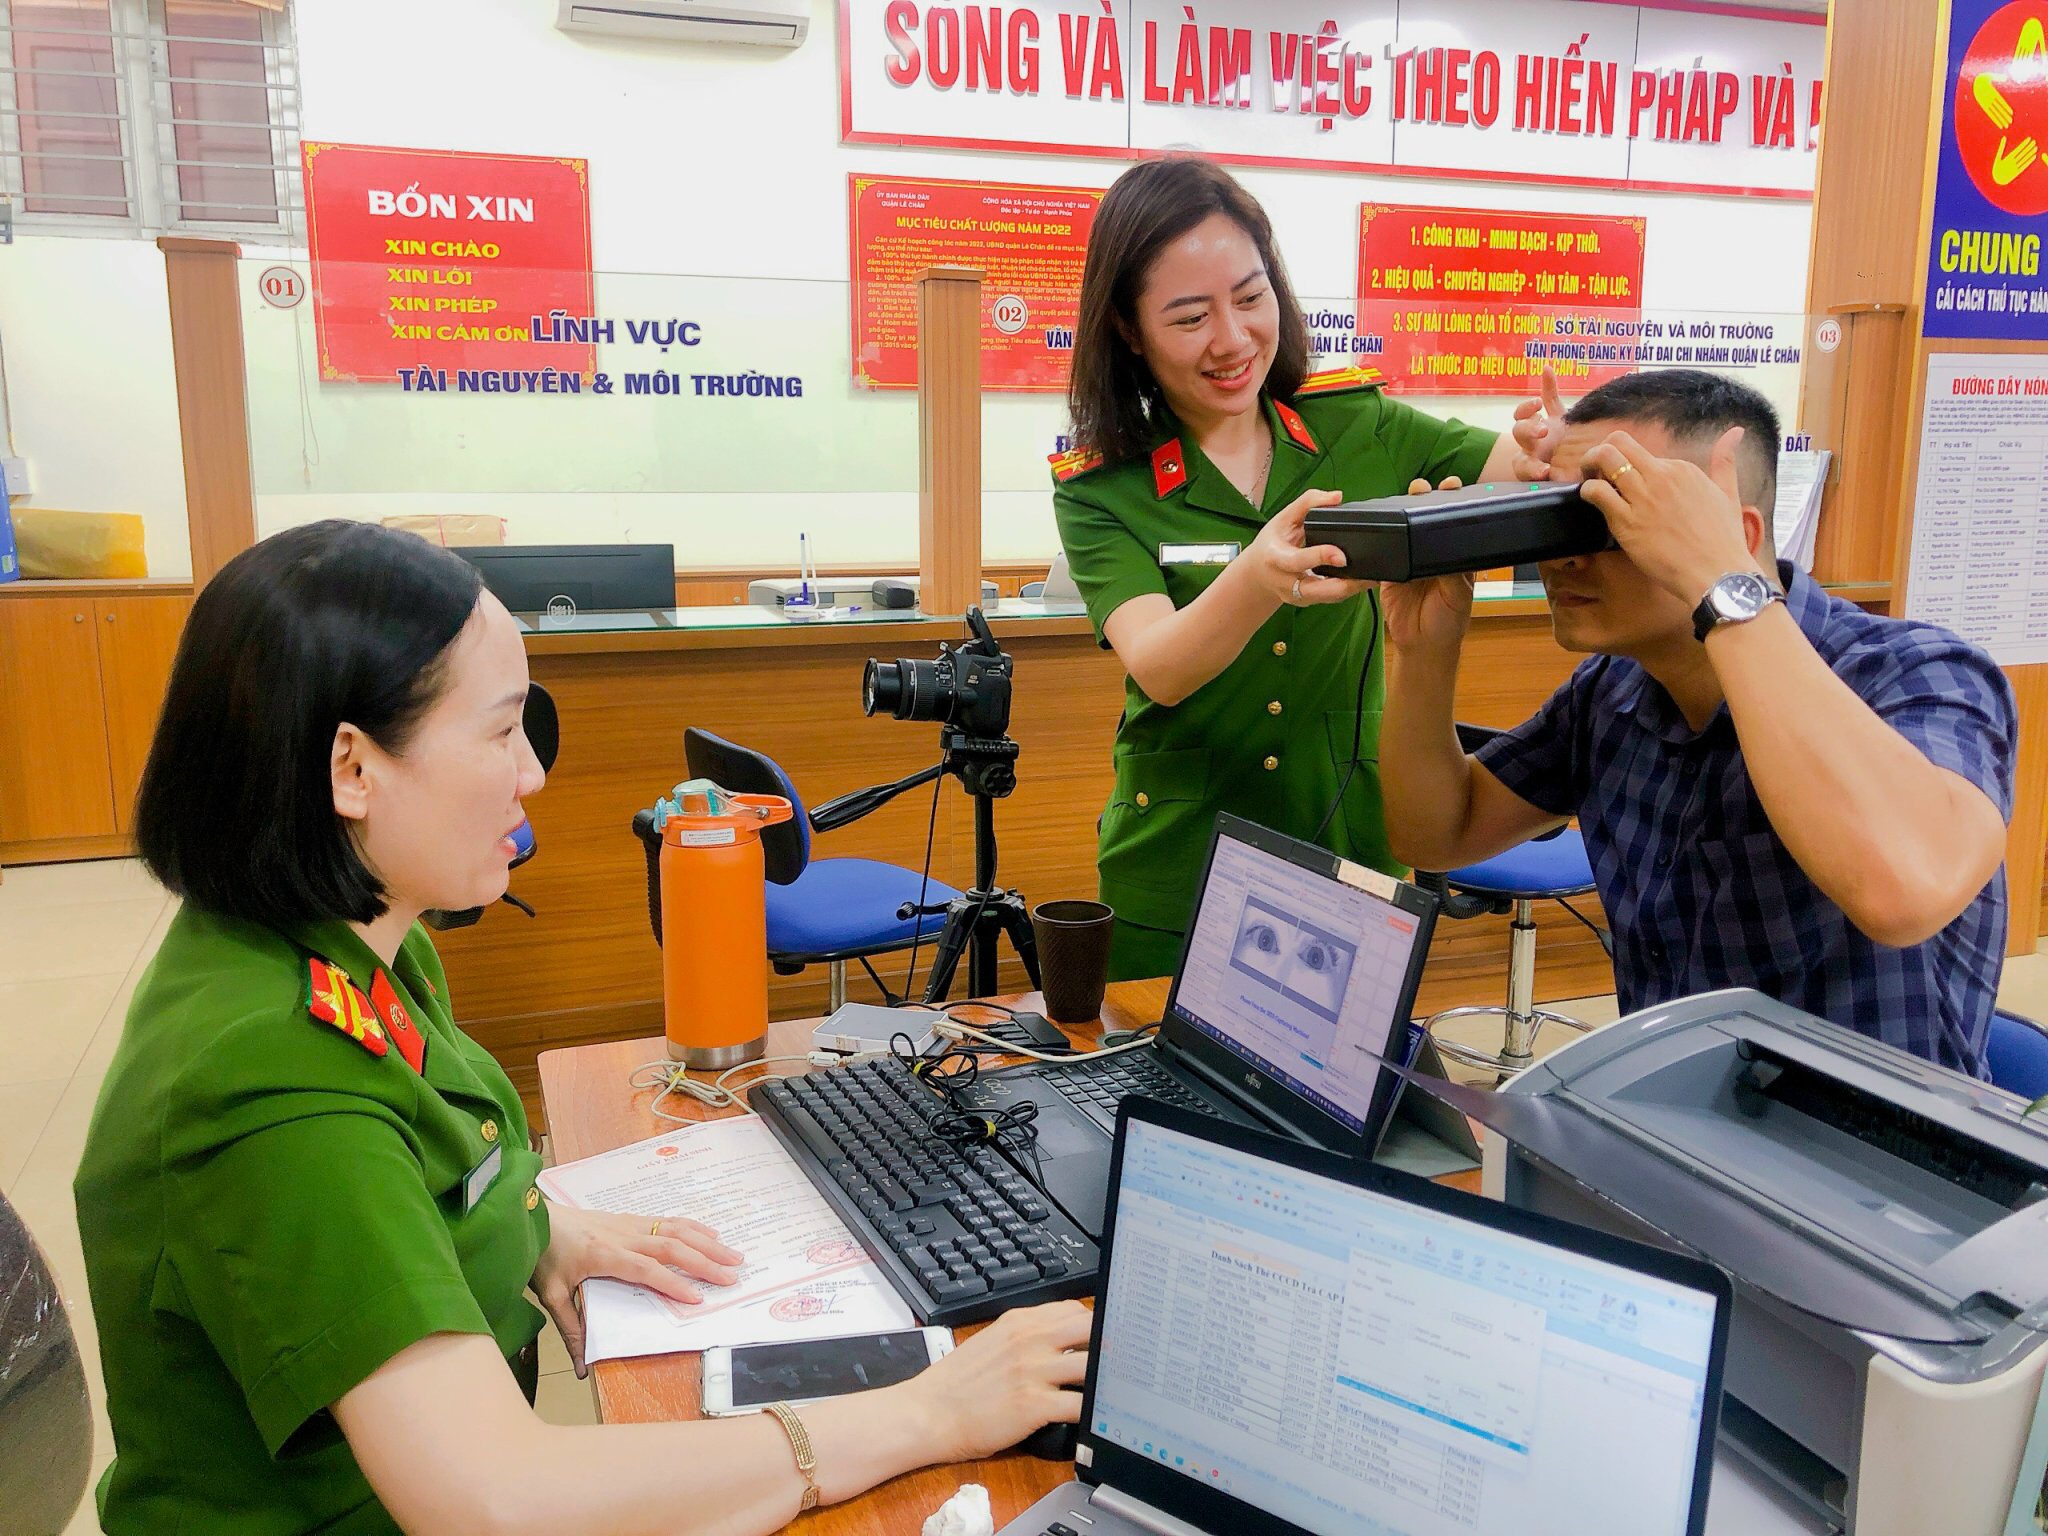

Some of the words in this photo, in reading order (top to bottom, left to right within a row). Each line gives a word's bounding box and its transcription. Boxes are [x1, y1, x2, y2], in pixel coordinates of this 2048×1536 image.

[1058, 0, 1125, 102] VÀ
[1143, 6, 1252, 108] LÀM
[1268, 19, 1373, 131] VIỆC
[1384, 45, 1500, 129] THEO
[1512, 33, 1617, 136] HIẾN
[1626, 56, 1738, 142] PHÁP
[1751, 62, 1795, 148] VÀ
[368, 181, 457, 219] BỐN
[466, 195, 535, 223] XIN
[896, 217, 920, 230] MỤC
[923, 216, 947, 229] TIÊU
[950, 217, 977, 231] CHẤT
[980, 221, 1015, 234] LƯỢNG
[1018, 222, 1041, 234] NĂM
[1043, 224, 1071, 235] 2022
[385, 239, 426, 255] XIN
[430, 239, 500, 258] CHÀO
[1411, 226, 1419, 245] 1.
[1423, 222, 1452, 247] CÔNG
[1455, 227, 1480, 248] KHAI
[1489, 229, 1517, 250] MINH
[1520, 231, 1547, 255] BẠCH
[1556, 233, 1573, 256] KỊP
[1576, 229, 1600, 253] THỜI.
[1940, 229, 2040, 276] CHUNG
[266, 277, 297, 296] 01
[387, 268, 428, 284] XIN
[1372, 268, 1381, 288] 2.
[1385, 265, 1410, 293] HIỆU
[1412, 264, 1434, 291] QUẢ
[1444, 268, 1485, 291] CHUYÊN
[1488, 268, 1526, 297] NGHIỆP
[1536, 270, 1555, 297] TẬN
[1558, 271, 1579, 294] TÂM
[1588, 272, 1607, 299] TẬN
[1610, 276, 1630, 300] LỰC.
[388, 296, 430, 312] XIN
[434, 296, 498, 313] PHÉP
[1936, 280, 1955, 310] CẢI
[1957, 284, 1985, 311] CÁCH
[1988, 282, 2007, 312] THỦ
[2009, 290, 2028, 317] TỤC
[998, 305, 1022, 322] 02
[1300, 309, 1355, 329] RƯỜNG
[1393, 312, 1403, 332] 3.
[1407, 311, 1422, 336] SỰ
[1444, 309, 1472, 333] LÒNG
[1475, 308, 1495, 333] CỦA
[1499, 307, 1513, 334] TỔ
[1514, 314, 1540, 335] CHỨC
[391, 324, 432, 339] XIN
[494, 324, 529, 342] ƠN
[533, 311, 615, 343] LĨNH
[626, 320, 701, 352] VỰC
[1555, 314, 1575, 335] SỞ
[1579, 316, 1600, 335] TÀI
[1606, 320, 1663, 337] NGUYÊN
[1669, 320, 1685, 338] VÀ
[1690, 322, 1715, 338] MÔI
[1720, 322, 1773, 339] TRƯỜNG
[1820, 329, 1837, 343] 03
[1046, 327, 1073, 348] VĂN
[1335, 334, 1348, 353] LÊ
[1352, 333, 1383, 353] CHÂN
[1410, 352, 1424, 376] LÀ
[1427, 352, 1461, 376] THƯỚC
[1464, 356, 1478, 376] ĐO
[1481, 352, 1504, 379] HIỆU
[1526, 340, 1547, 358] VĂN
[1550, 342, 1585, 359] PHÒNG
[1588, 344, 1616, 360] ĐĂNG
[1635, 340, 1654, 361] ĐẤT
[1657, 346, 1672, 361] ĐAI
[1676, 347, 1692, 361] CHI
[1695, 345, 1728, 362] NHÁNH
[1732, 348, 1758, 366] QUẬN
[1760, 347, 1771, 362] LÊ
[1774, 347, 1800, 363] CHÂN
[398, 367, 448, 392] TÀI
[457, 368, 581, 394] NGUYÊN
[592, 373, 614, 395] &
[624, 371, 681, 395] MÔI
[690, 370, 803, 397] TRƯỜNG
[1952, 375, 1994, 395] ĐƯỜNG
[1997, 375, 2021, 395] DÂY
[1785, 429, 1811, 452] ĐẤT
